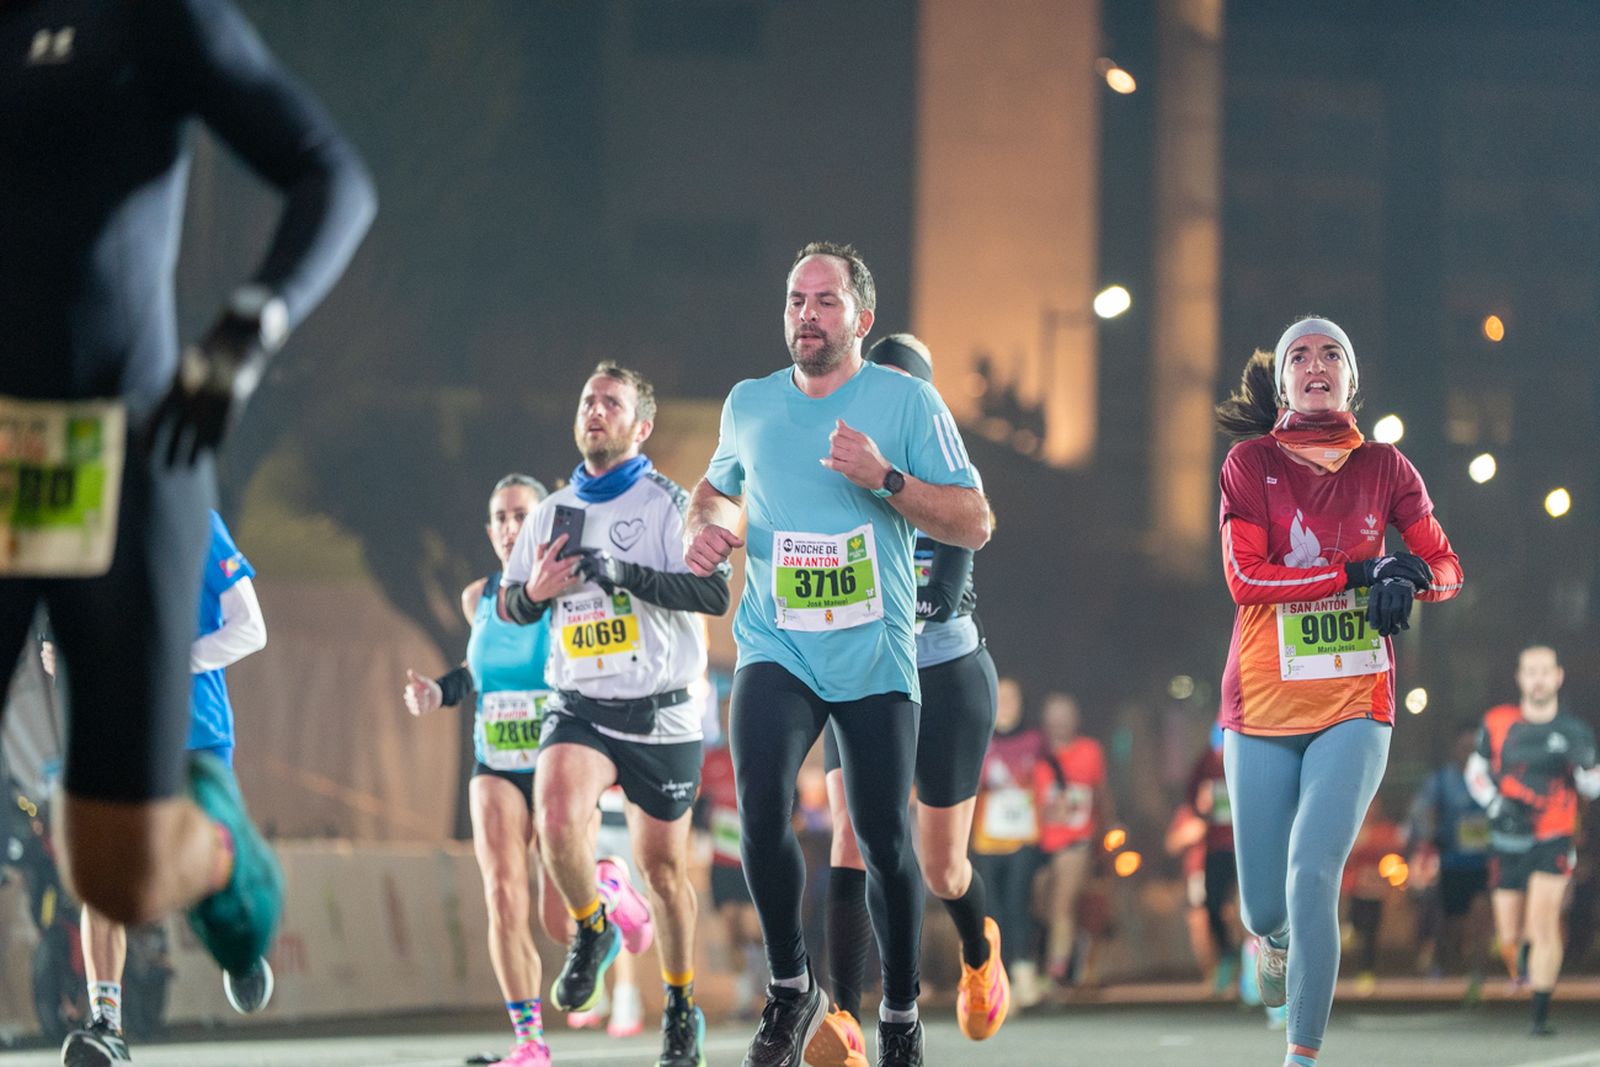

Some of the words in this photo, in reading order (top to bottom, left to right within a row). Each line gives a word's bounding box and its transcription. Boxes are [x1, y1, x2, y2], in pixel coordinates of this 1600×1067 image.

[783, 556, 802, 567] SAN
[804, 555, 839, 567] ANTÓN
[794, 544, 824, 555] NOCHE
[825, 545, 838, 555] DE
[795, 566, 856, 598] 3716
[1290, 602, 1312, 614] SAN
[1314, 598, 1348, 612] ANTÓN
[572, 619, 626, 649] 4069
[1301, 611, 1365, 645] 9067
[495, 720, 541, 743] 2816
